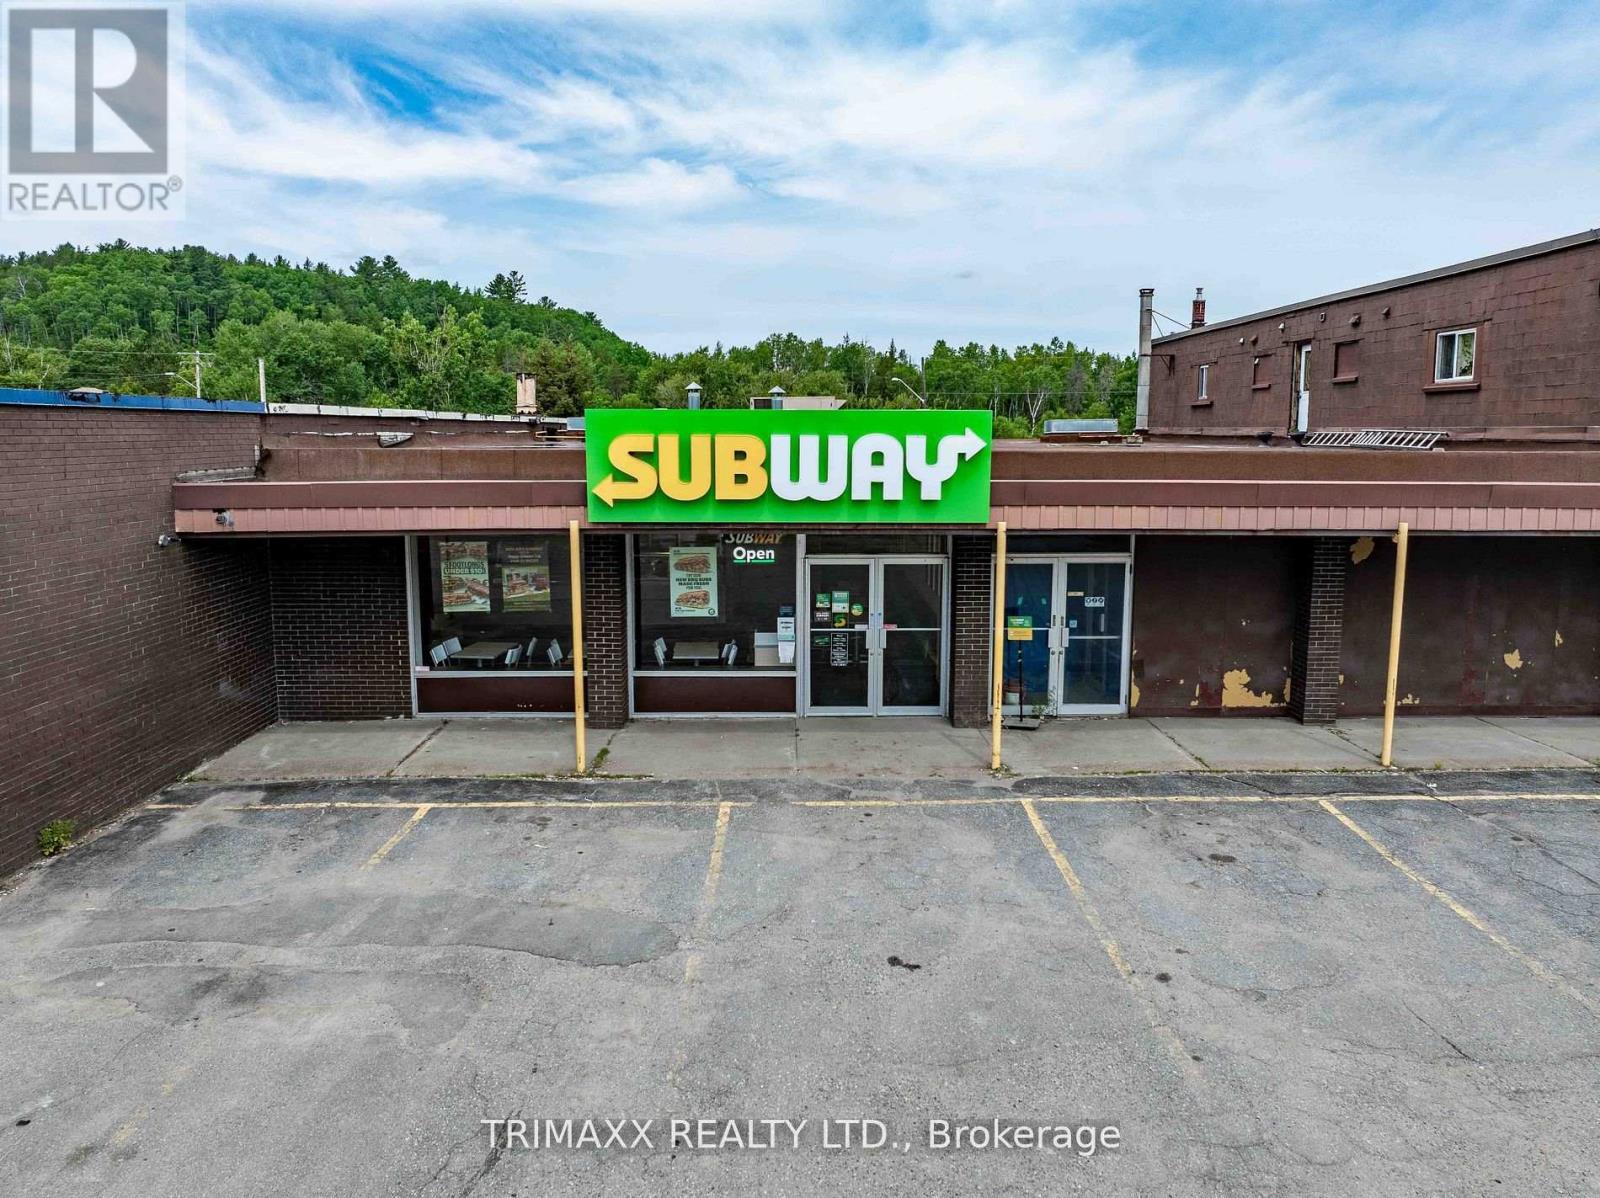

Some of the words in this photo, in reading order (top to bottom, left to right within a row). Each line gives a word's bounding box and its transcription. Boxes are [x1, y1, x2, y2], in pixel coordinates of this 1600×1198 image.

[592, 432, 988, 507] SUBWAY
[724, 533, 783, 544] SUBWAY
[732, 546, 775, 563] Open
